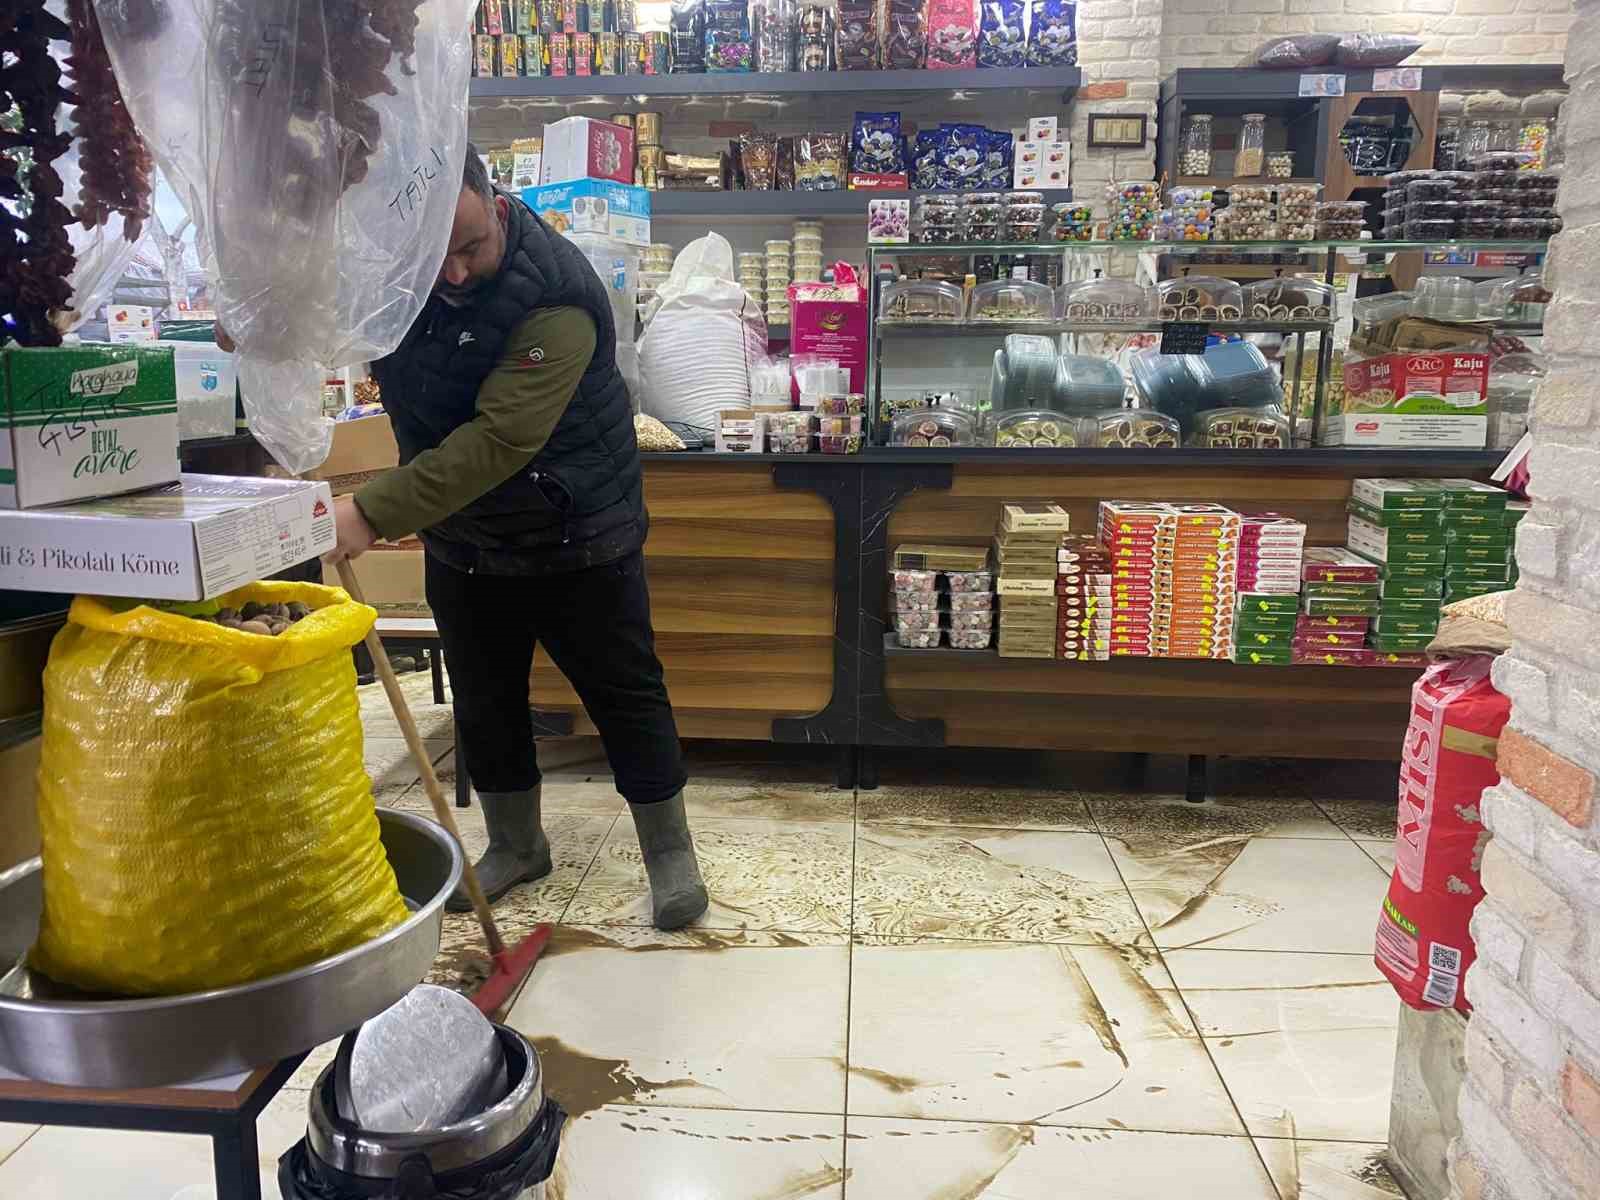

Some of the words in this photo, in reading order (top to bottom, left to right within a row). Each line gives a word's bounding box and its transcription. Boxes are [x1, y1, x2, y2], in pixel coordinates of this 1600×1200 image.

[1369, 363, 1390, 378] Kaju
[1410, 359, 1441, 371] ARC
[1453, 357, 1484, 370] Kaju
[122, 552, 181, 576] Köme
